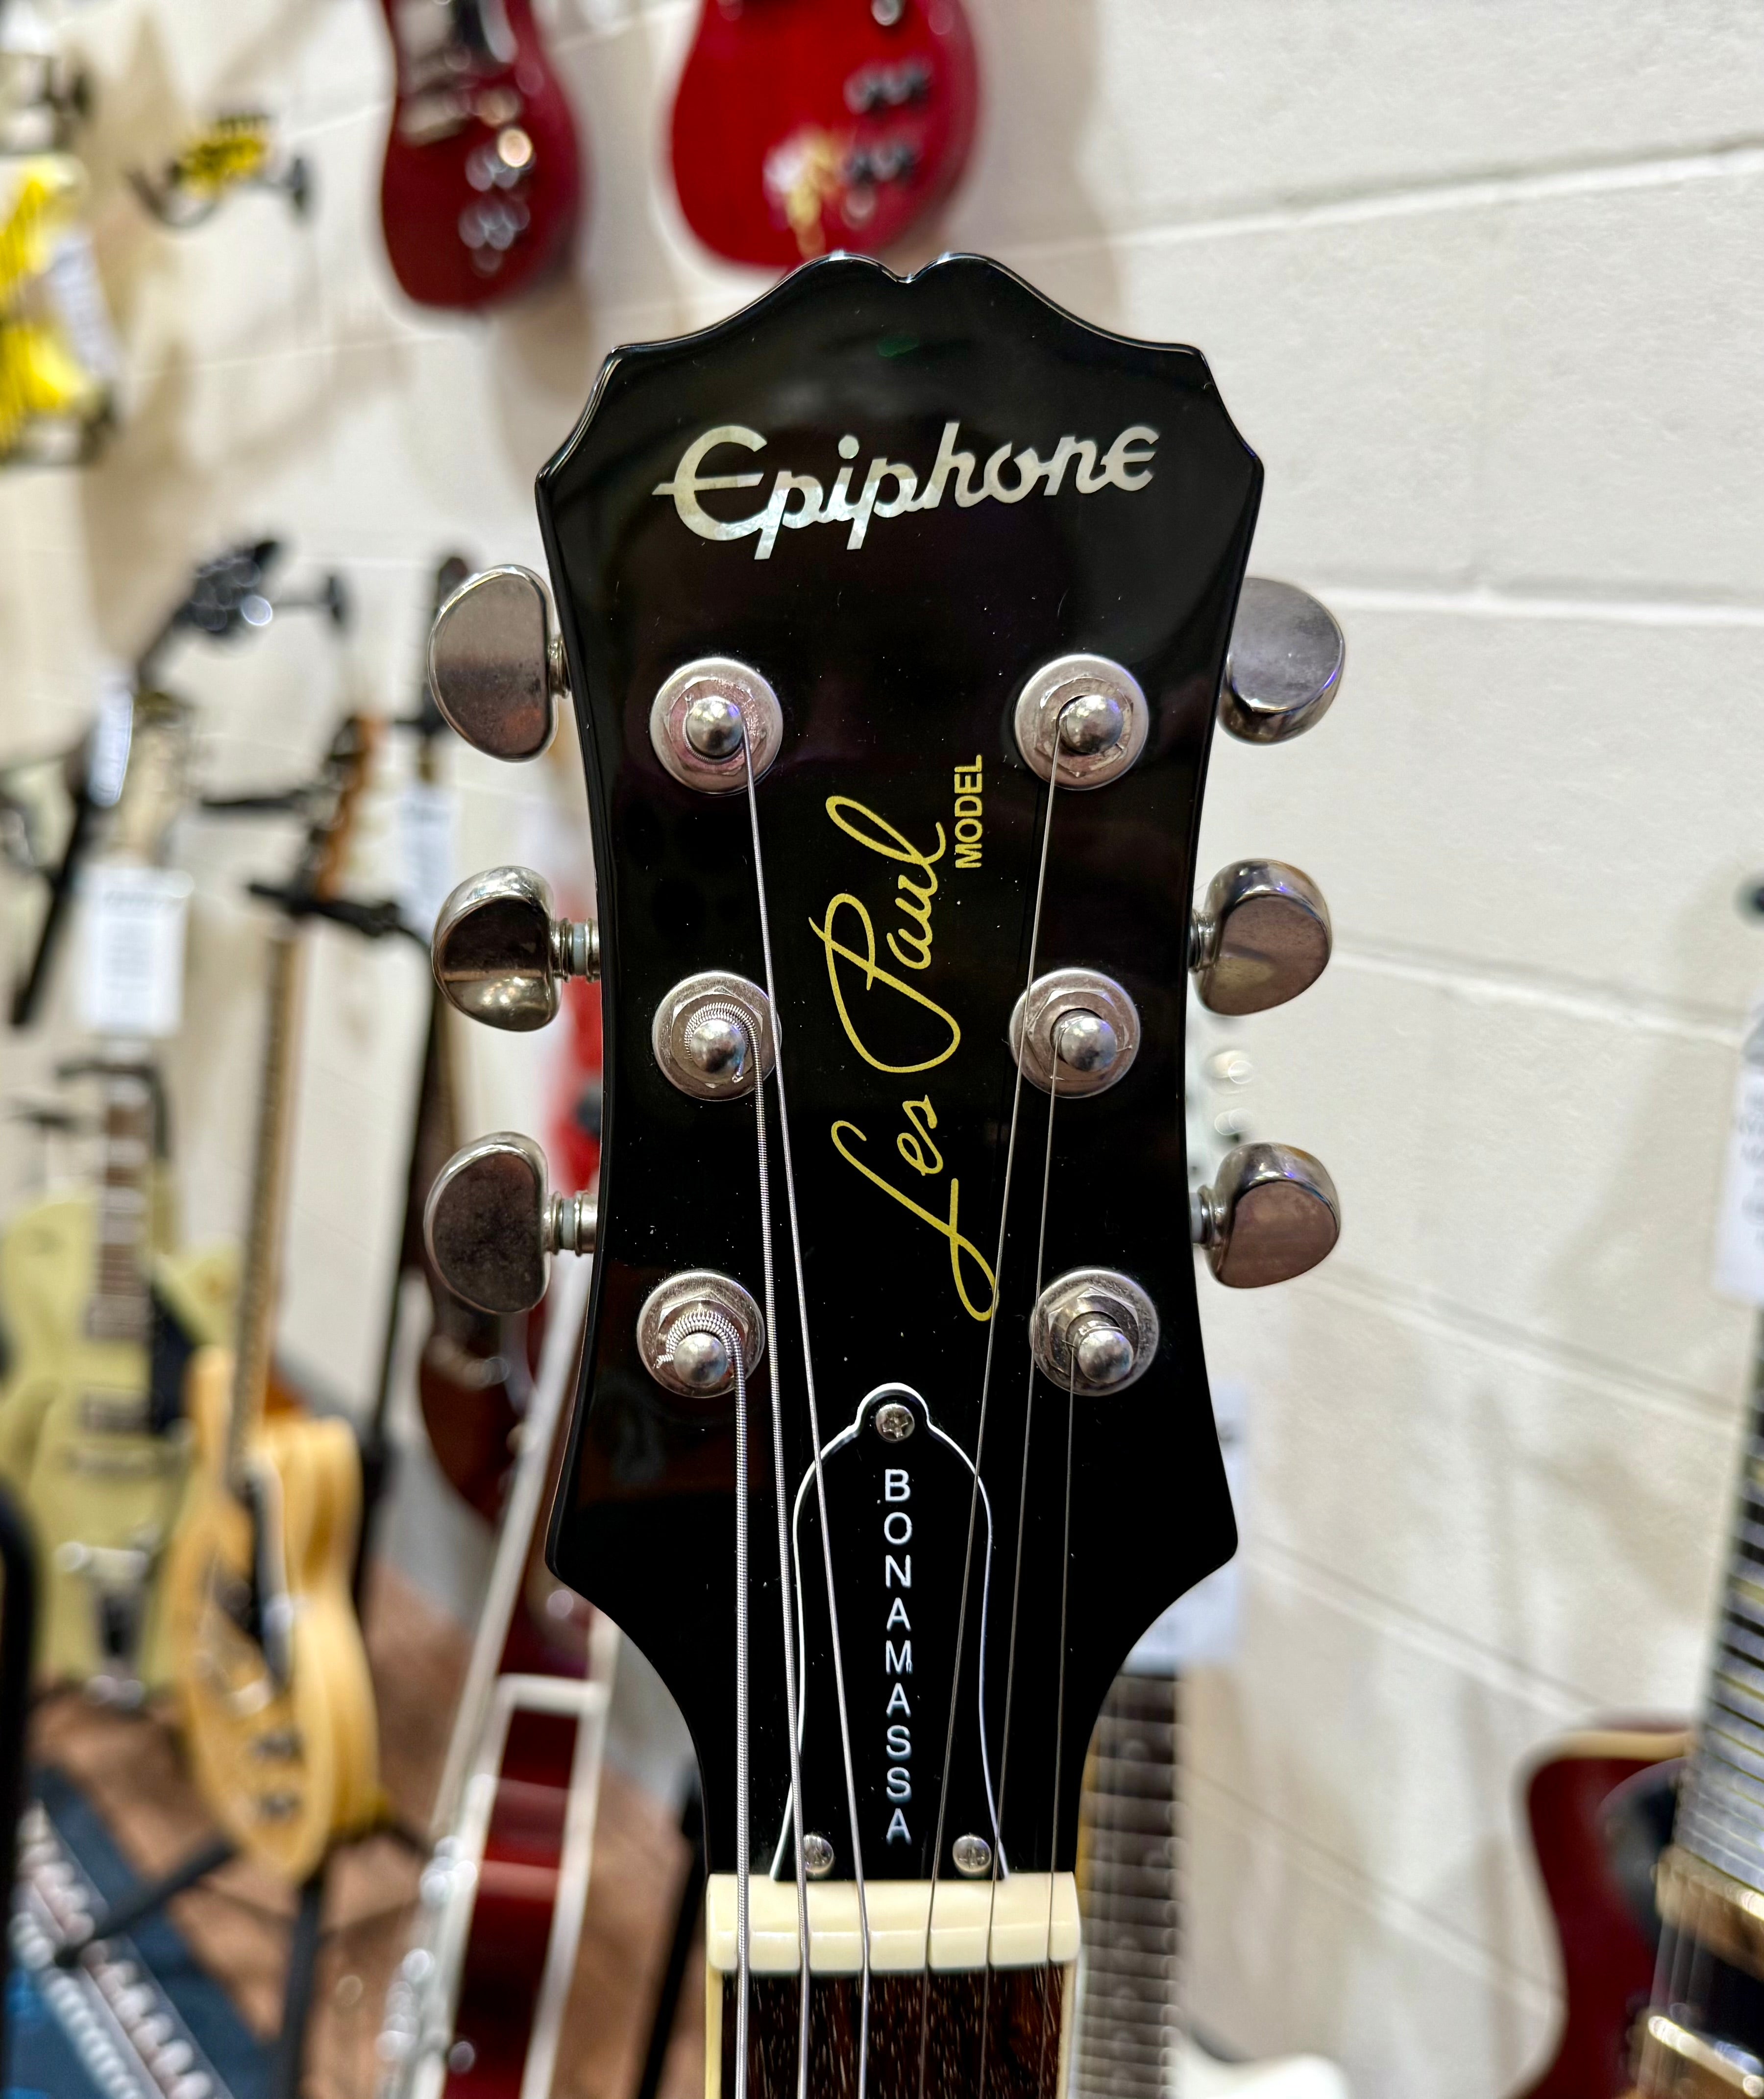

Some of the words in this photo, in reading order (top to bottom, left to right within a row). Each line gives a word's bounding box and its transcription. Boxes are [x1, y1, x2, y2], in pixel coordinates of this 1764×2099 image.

[652, 421, 1160, 561] Epiphone
[954, 754, 983, 868] MODEL
[809, 795, 961, 1073] Paul
[831, 1096, 997, 1321] Les
[883, 1468, 912, 1844] BONAMASSA
